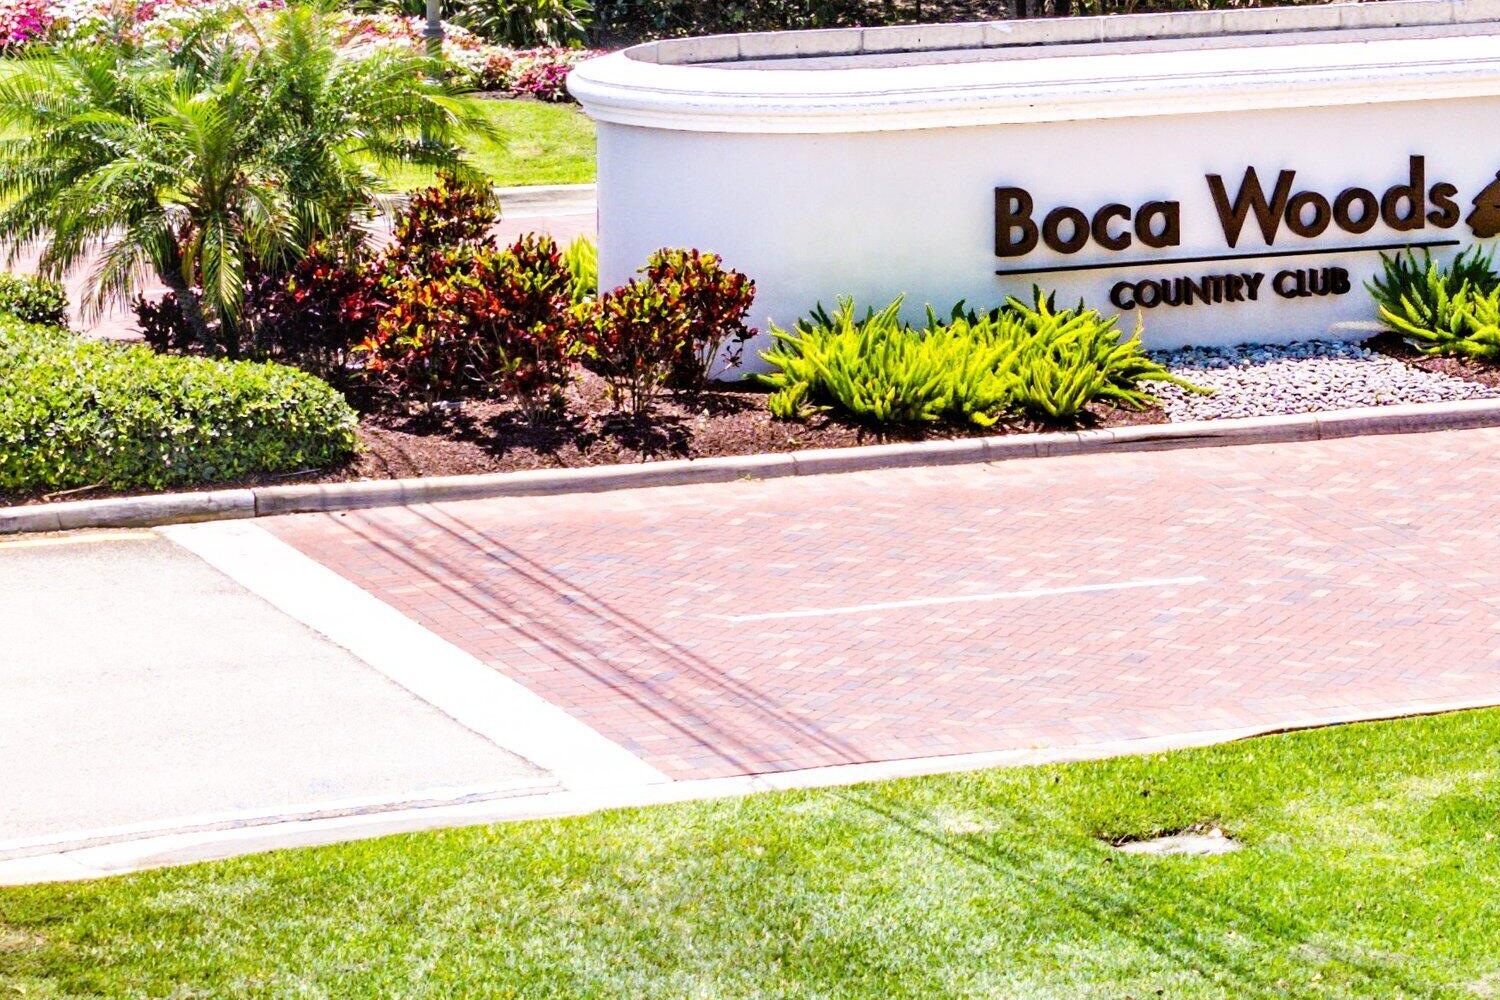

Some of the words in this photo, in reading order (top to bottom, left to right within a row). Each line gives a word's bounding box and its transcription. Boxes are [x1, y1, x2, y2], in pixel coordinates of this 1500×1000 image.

[995, 186, 1180, 257] Boca
[1205, 154, 1460, 248] Woods
[1109, 272, 1265, 310] COUNTRY
[1272, 267, 1351, 298] CLUB
